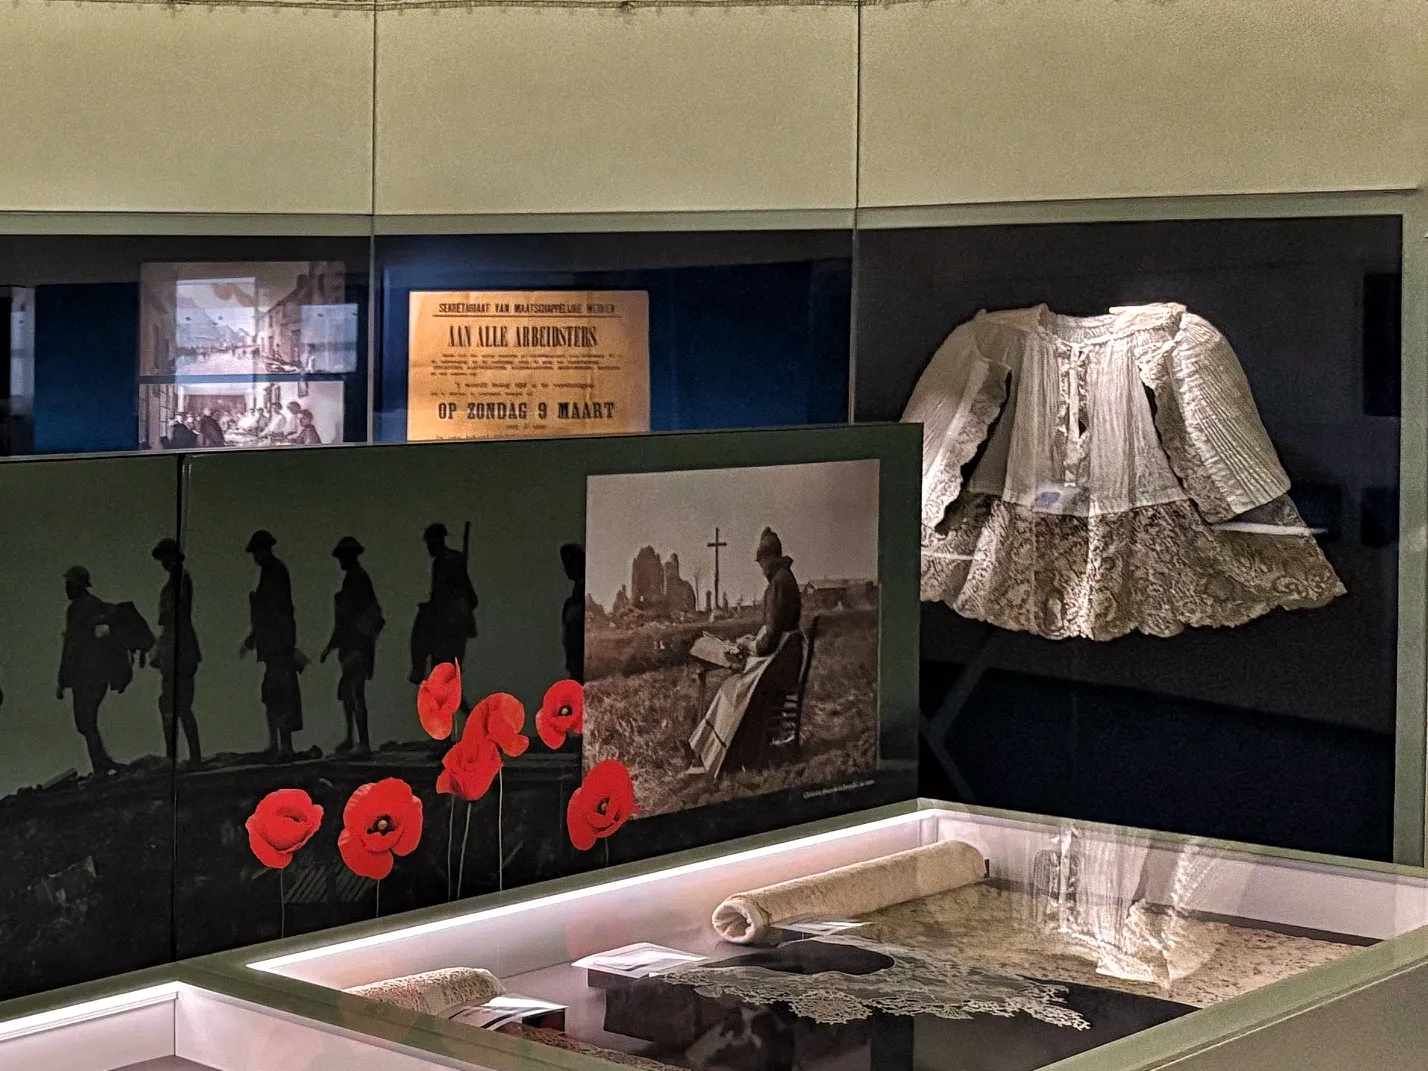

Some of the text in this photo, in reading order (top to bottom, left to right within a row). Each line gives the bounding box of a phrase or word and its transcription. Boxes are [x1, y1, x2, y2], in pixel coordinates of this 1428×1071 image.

[495, 303, 510, 313] VAN
[448, 325, 598, 347] AAN ALLE ARBEIDSTERS
[438, 402, 615, 420] OP ZONDAG 9 MAART
